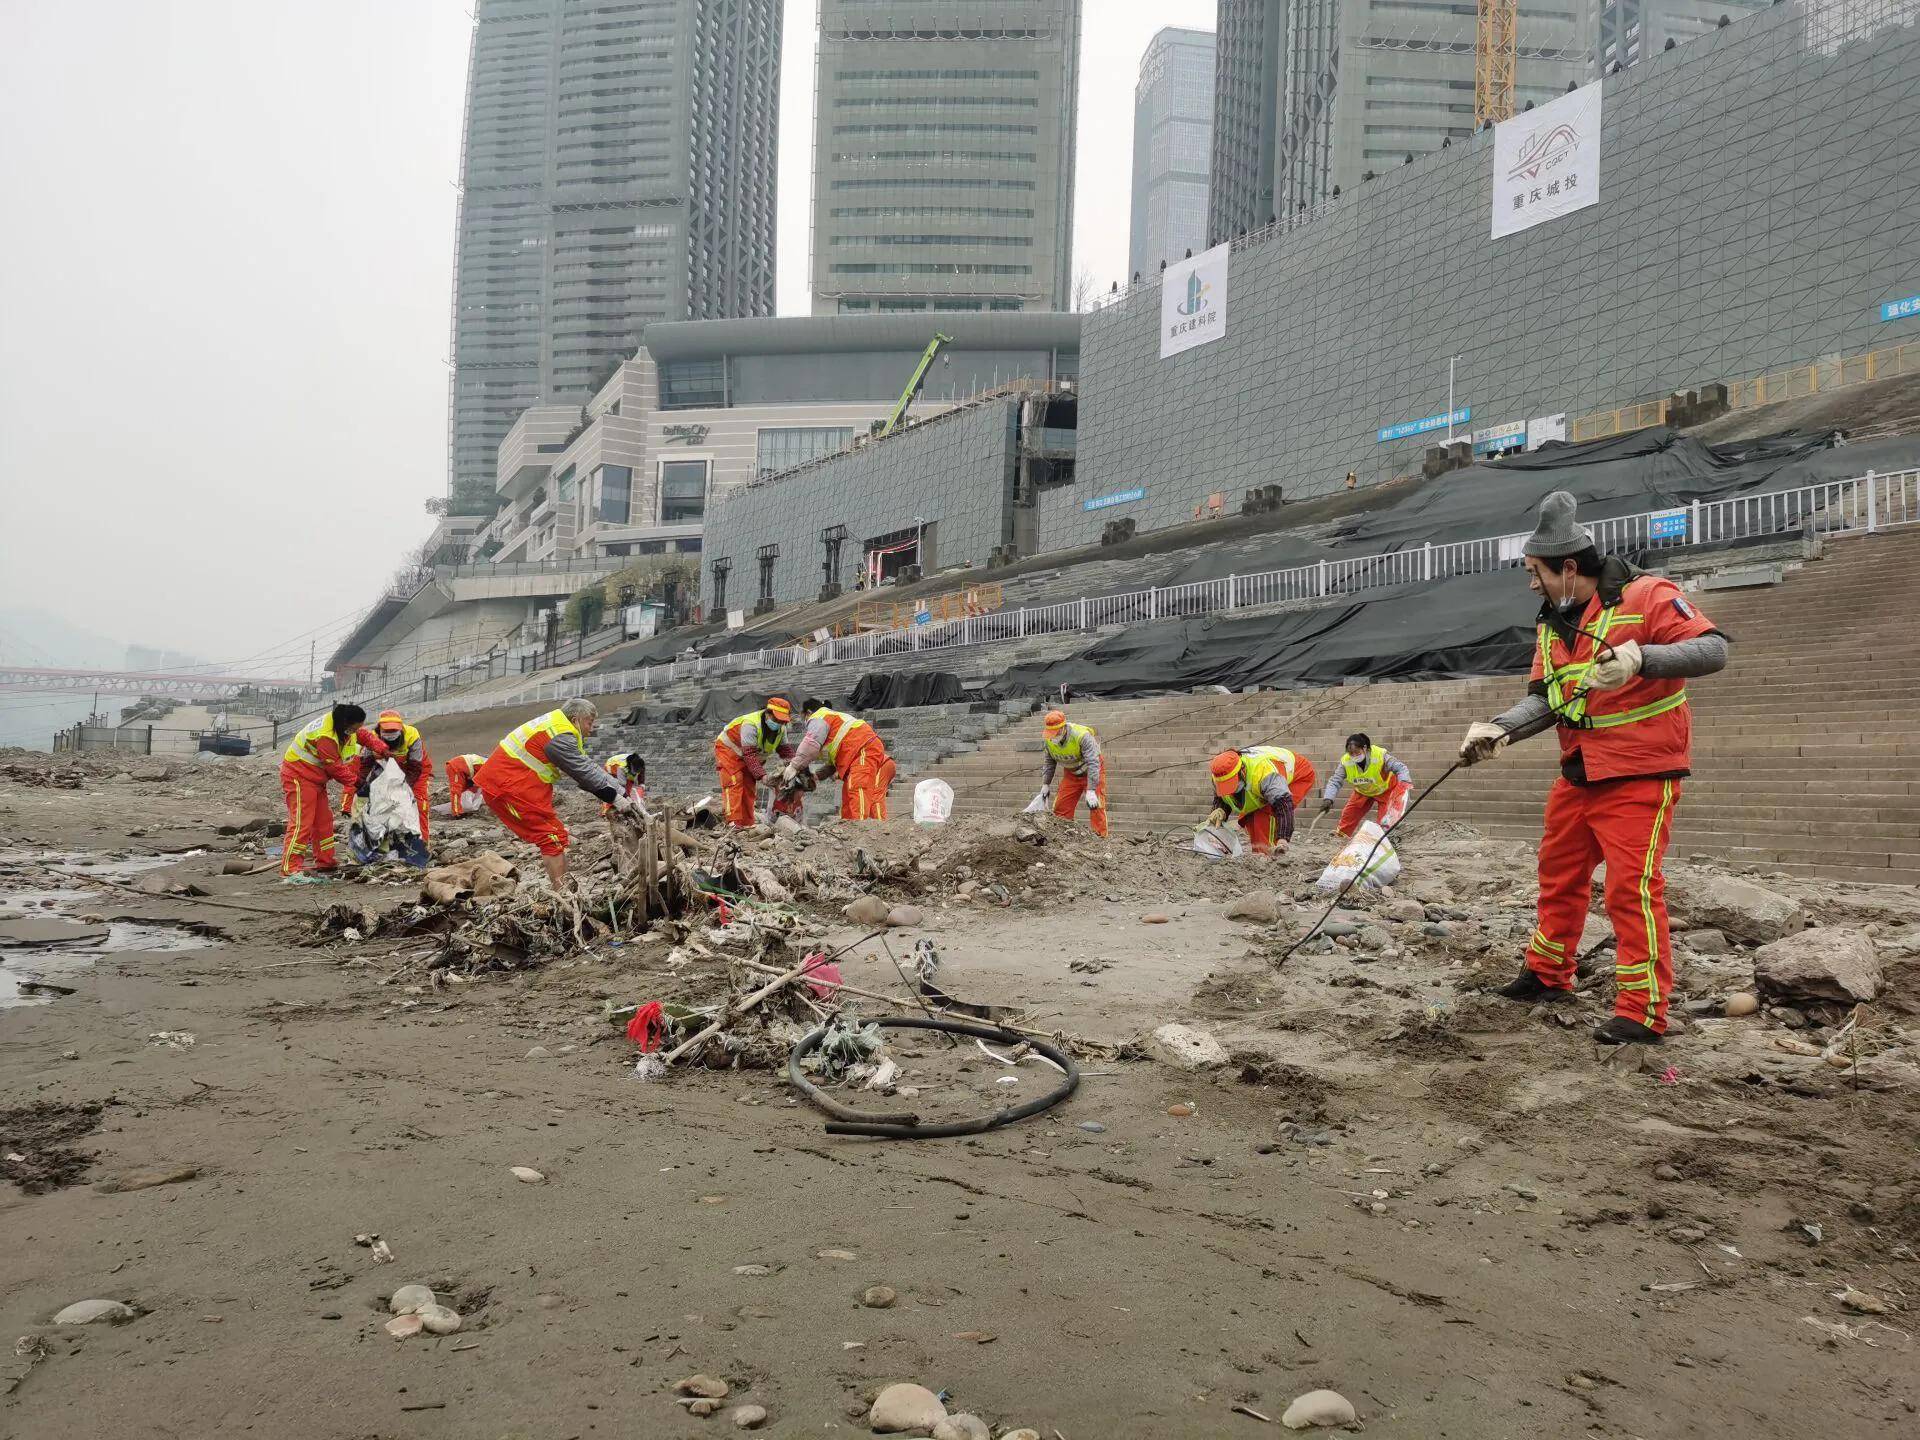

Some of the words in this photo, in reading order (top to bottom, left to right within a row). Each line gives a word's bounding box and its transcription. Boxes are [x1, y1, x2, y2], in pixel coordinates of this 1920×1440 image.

[1512, 173, 1578, 211] 重庆城投
[1170, 311, 1217, 338] 重庆建科院
